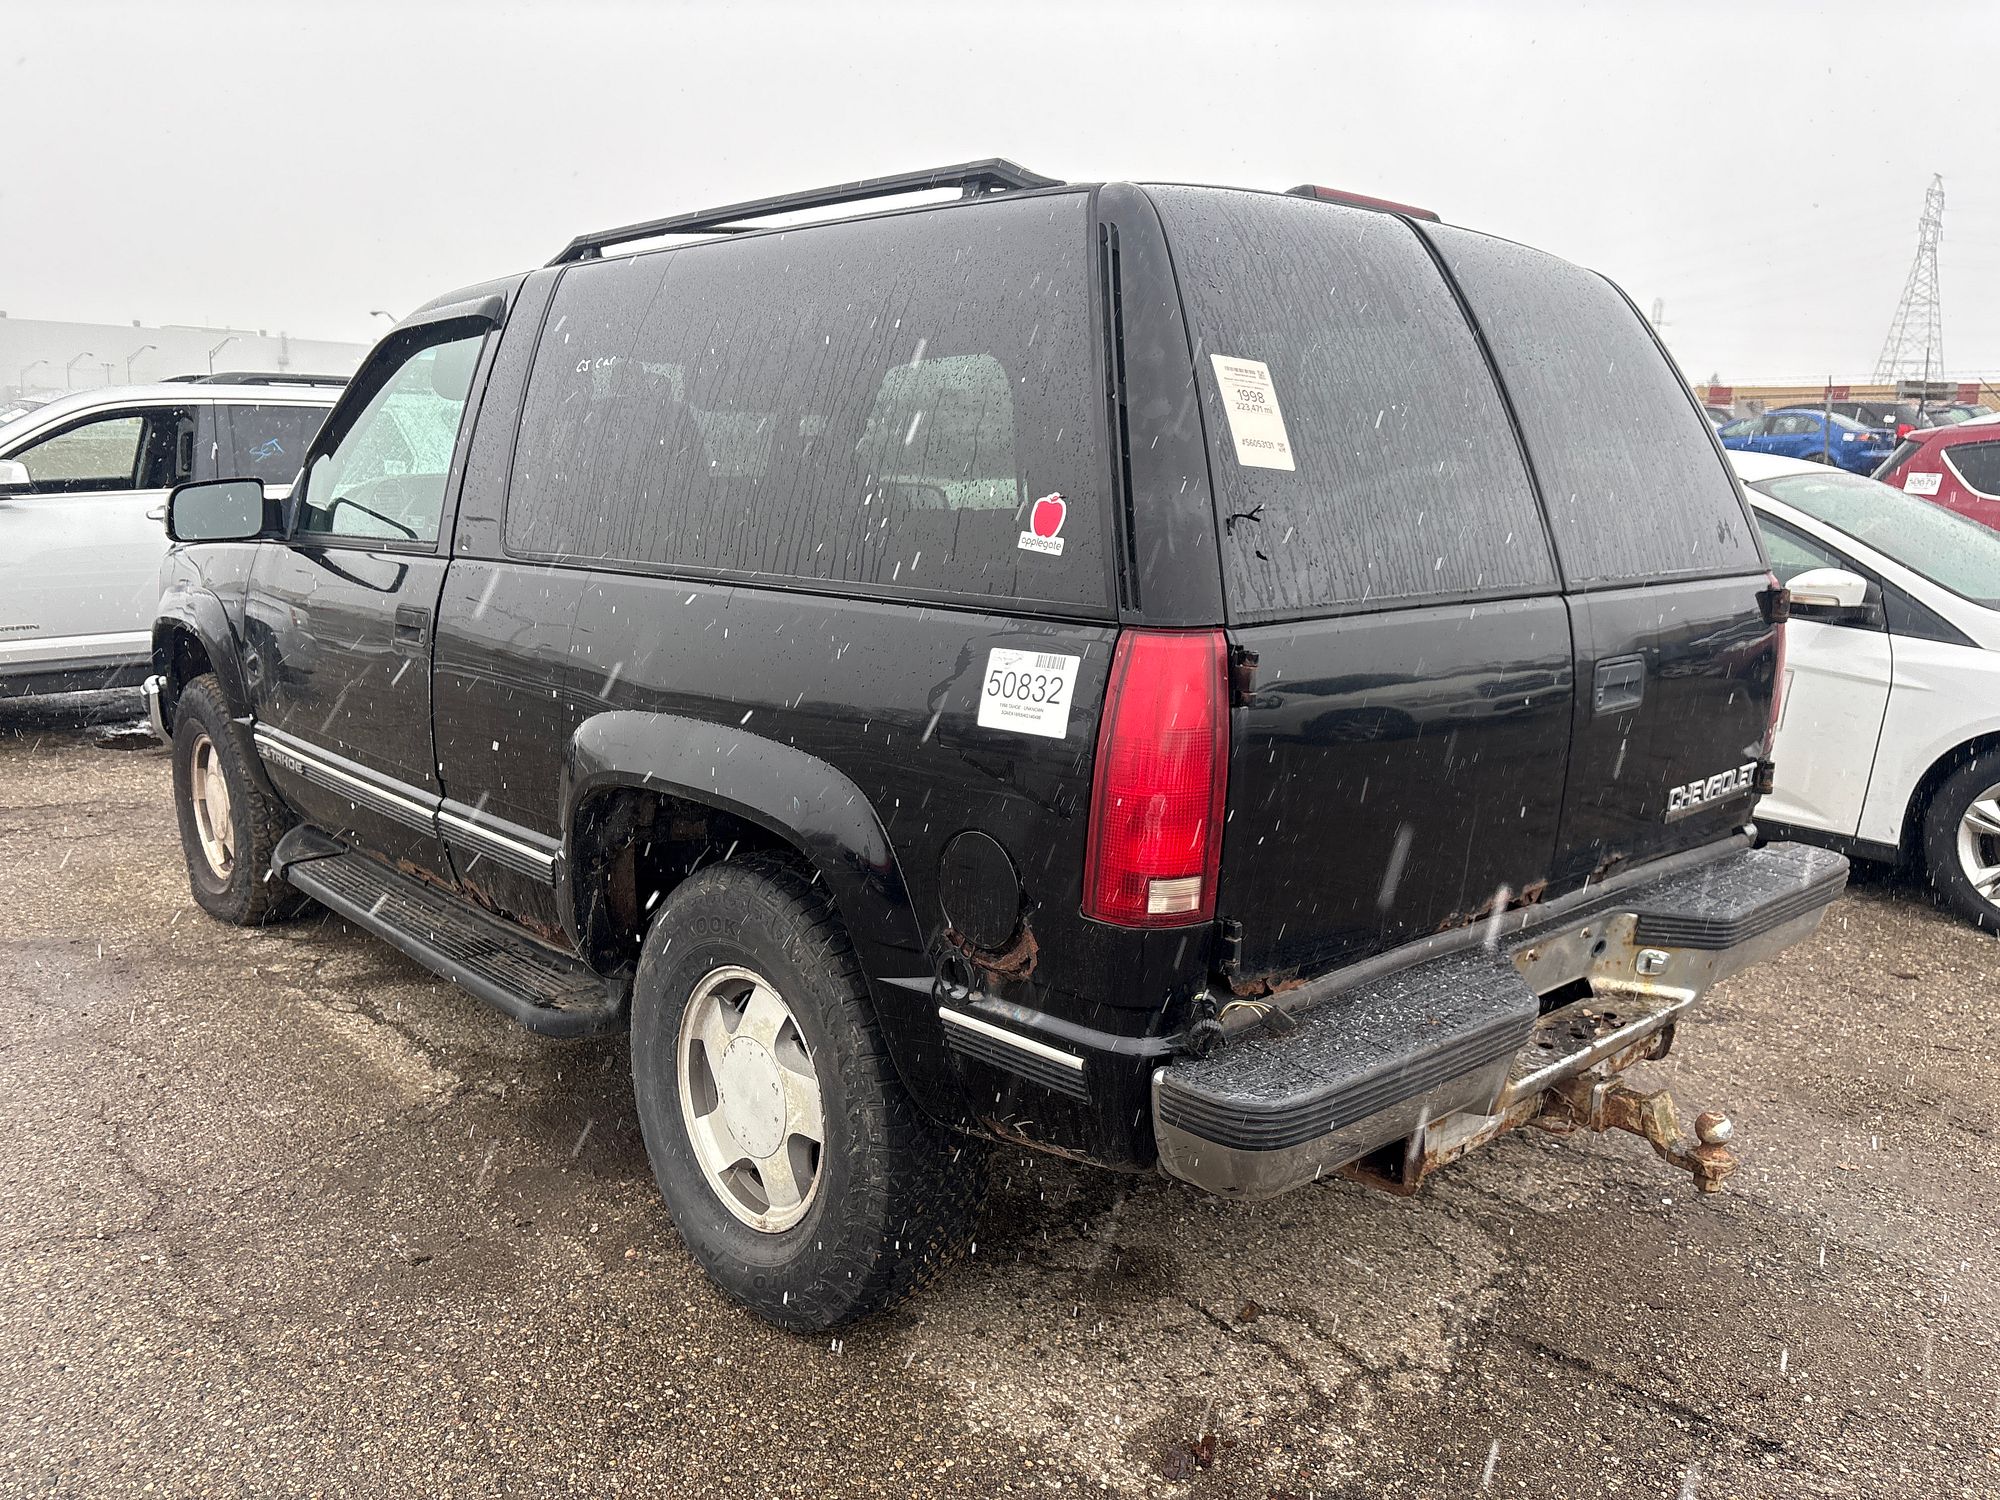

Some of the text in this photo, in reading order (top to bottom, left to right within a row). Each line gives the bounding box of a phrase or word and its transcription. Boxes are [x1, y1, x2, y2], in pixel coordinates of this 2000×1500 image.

[1237, 389, 1265, 403] 1998
[1021, 537, 1062, 550] applegate
[987, 670, 1063, 704] 50832
[270, 749, 304, 774] TAHOE
[1667, 761, 1758, 811] CHEVROLET
